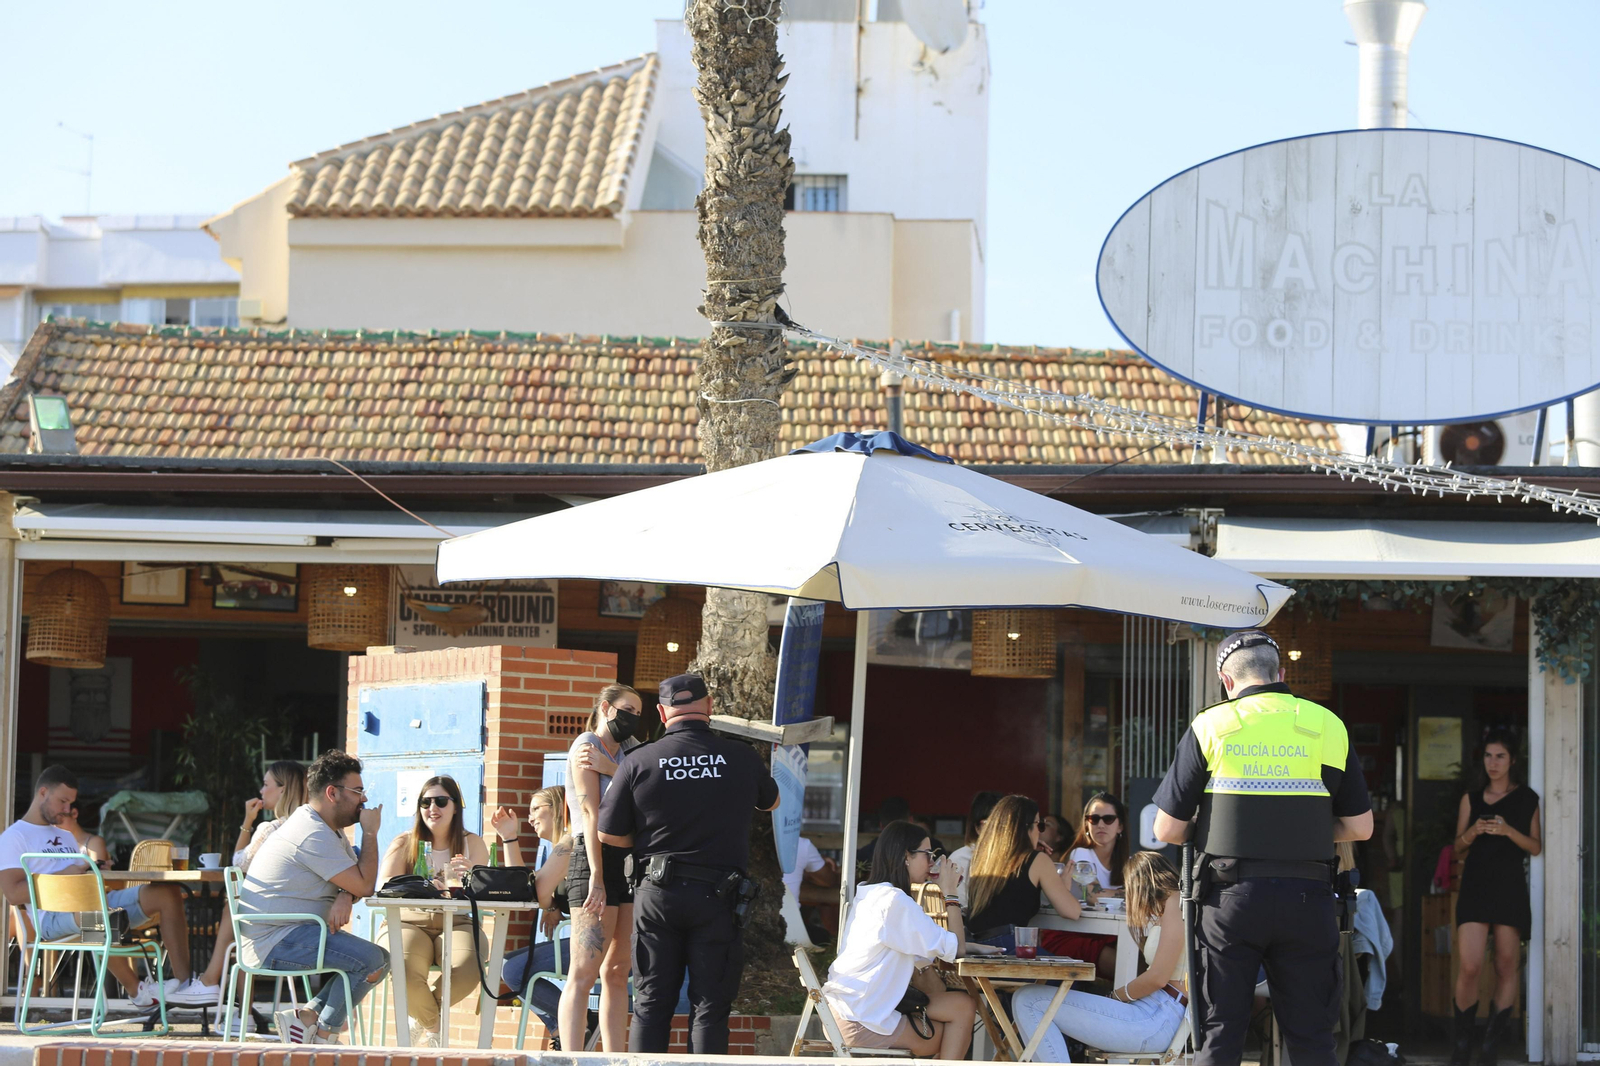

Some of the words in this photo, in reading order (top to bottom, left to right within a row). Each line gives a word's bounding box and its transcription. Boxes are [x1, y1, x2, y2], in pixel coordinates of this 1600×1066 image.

[1368, 172, 1431, 207] LA
[1204, 197, 1593, 297] MACHINA
[1198, 314, 1330, 350] FOOD
[1355, 319, 1388, 352] &
[1409, 319, 1592, 356] DRINKS
[948, 522, 1089, 541] CERVECISTAS
[463, 625, 505, 637] RAINING
[507, 626, 540, 638] CENTER
[1225, 742, 1270, 757] POLICÍA
[1272, 745, 1309, 758] LOCAL
[658, 754, 727, 769] POLICIA
[1243, 761, 1290, 777] MÁLAGA
[665, 767, 722, 781] LOCAL
